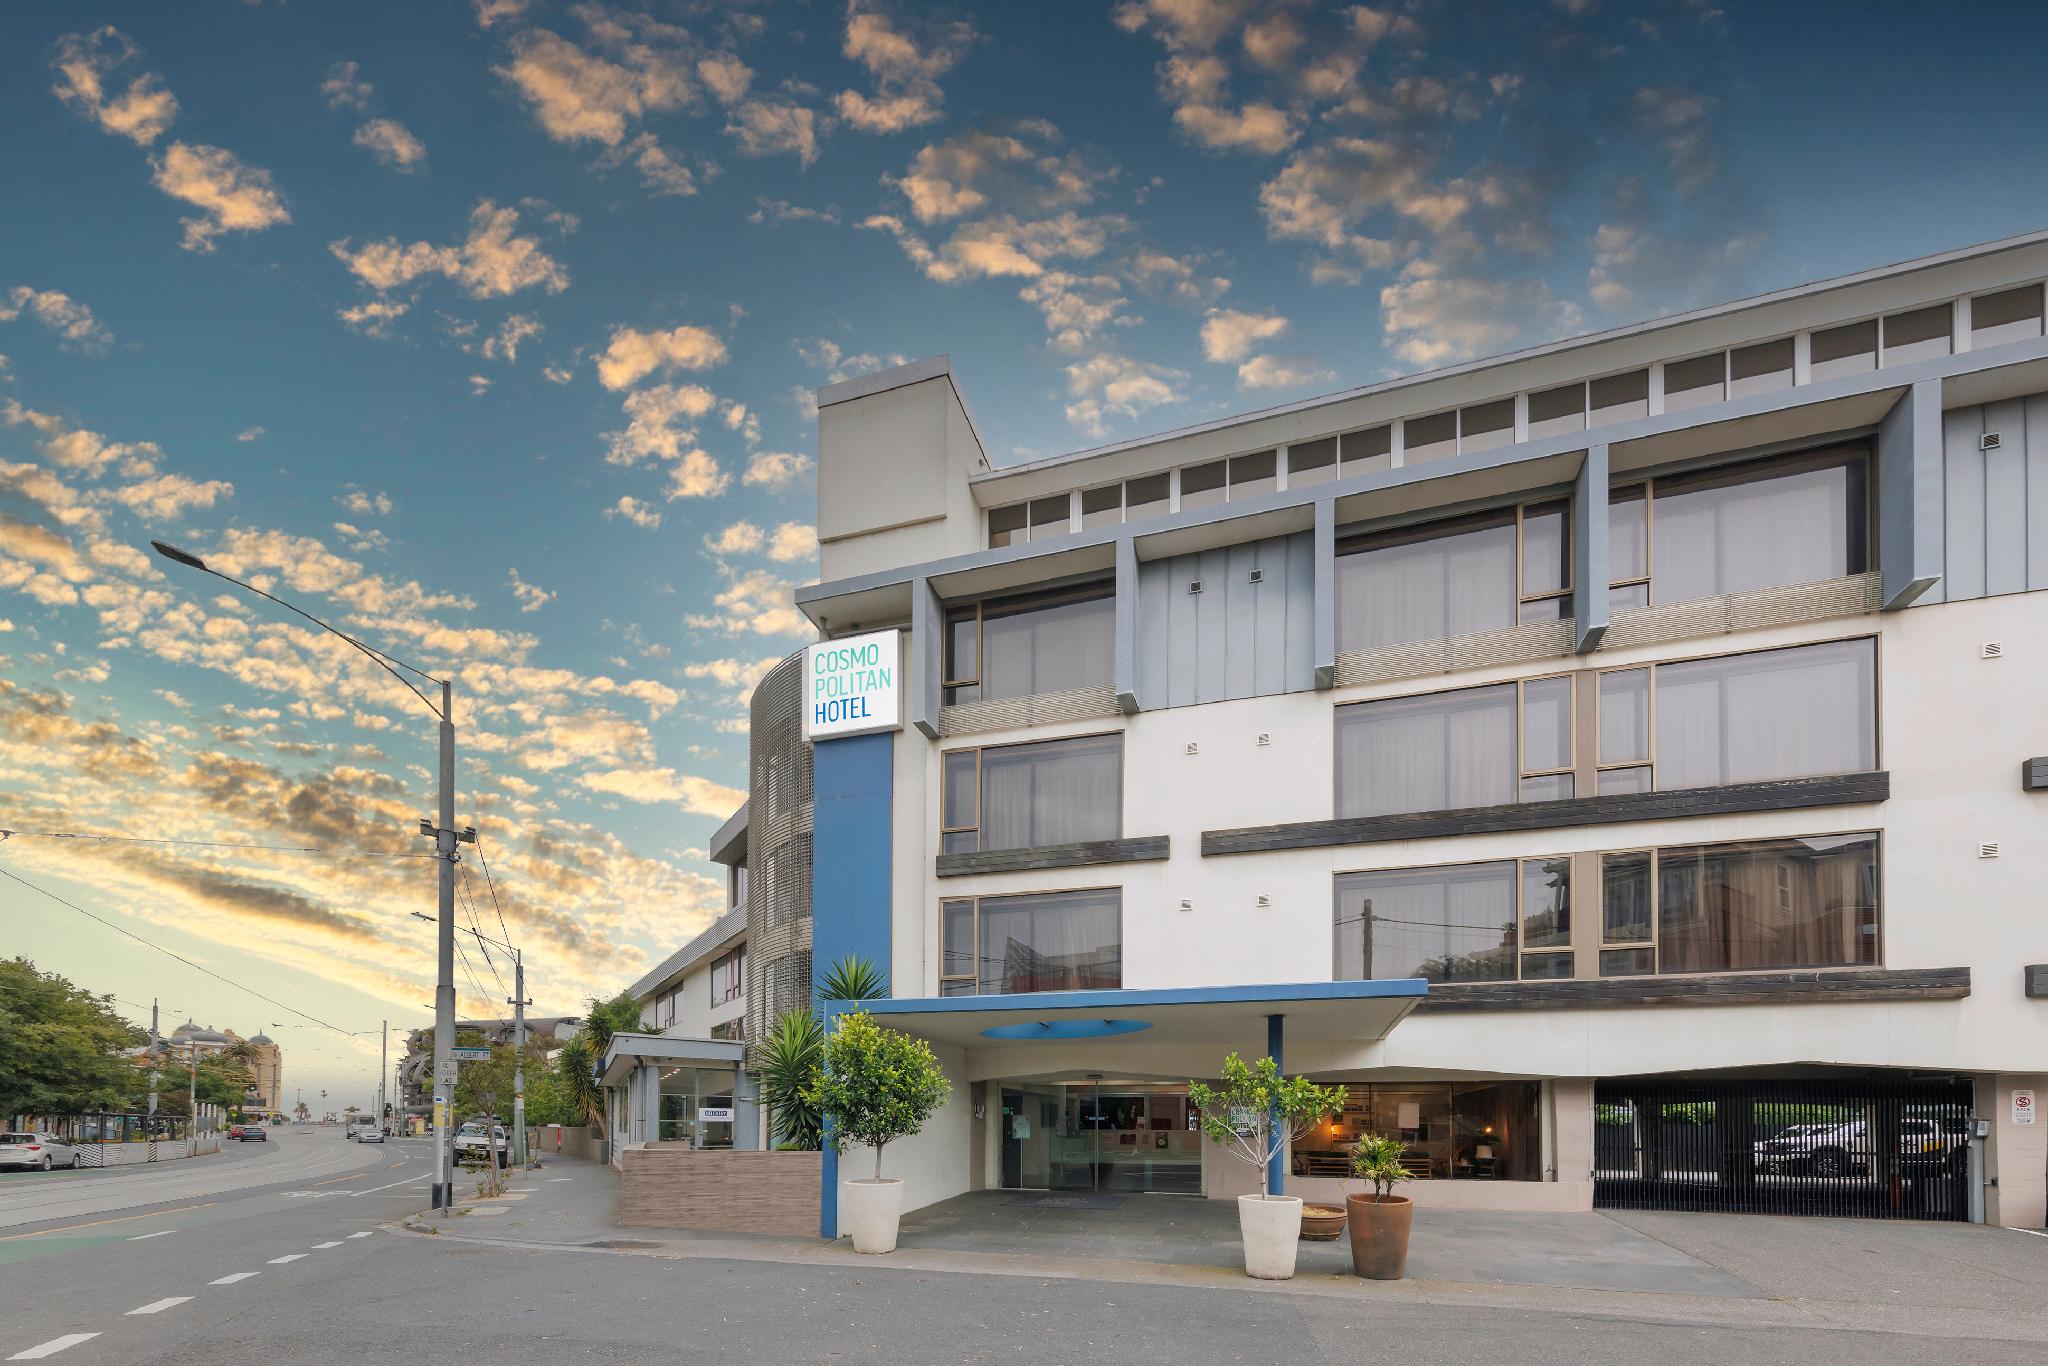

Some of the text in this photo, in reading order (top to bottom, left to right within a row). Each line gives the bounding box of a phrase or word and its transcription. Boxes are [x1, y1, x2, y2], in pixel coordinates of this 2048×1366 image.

[815, 643, 879, 675] COSMO
[815, 667, 891, 700] POLITAN
[815, 696, 871, 724] HOTEL
